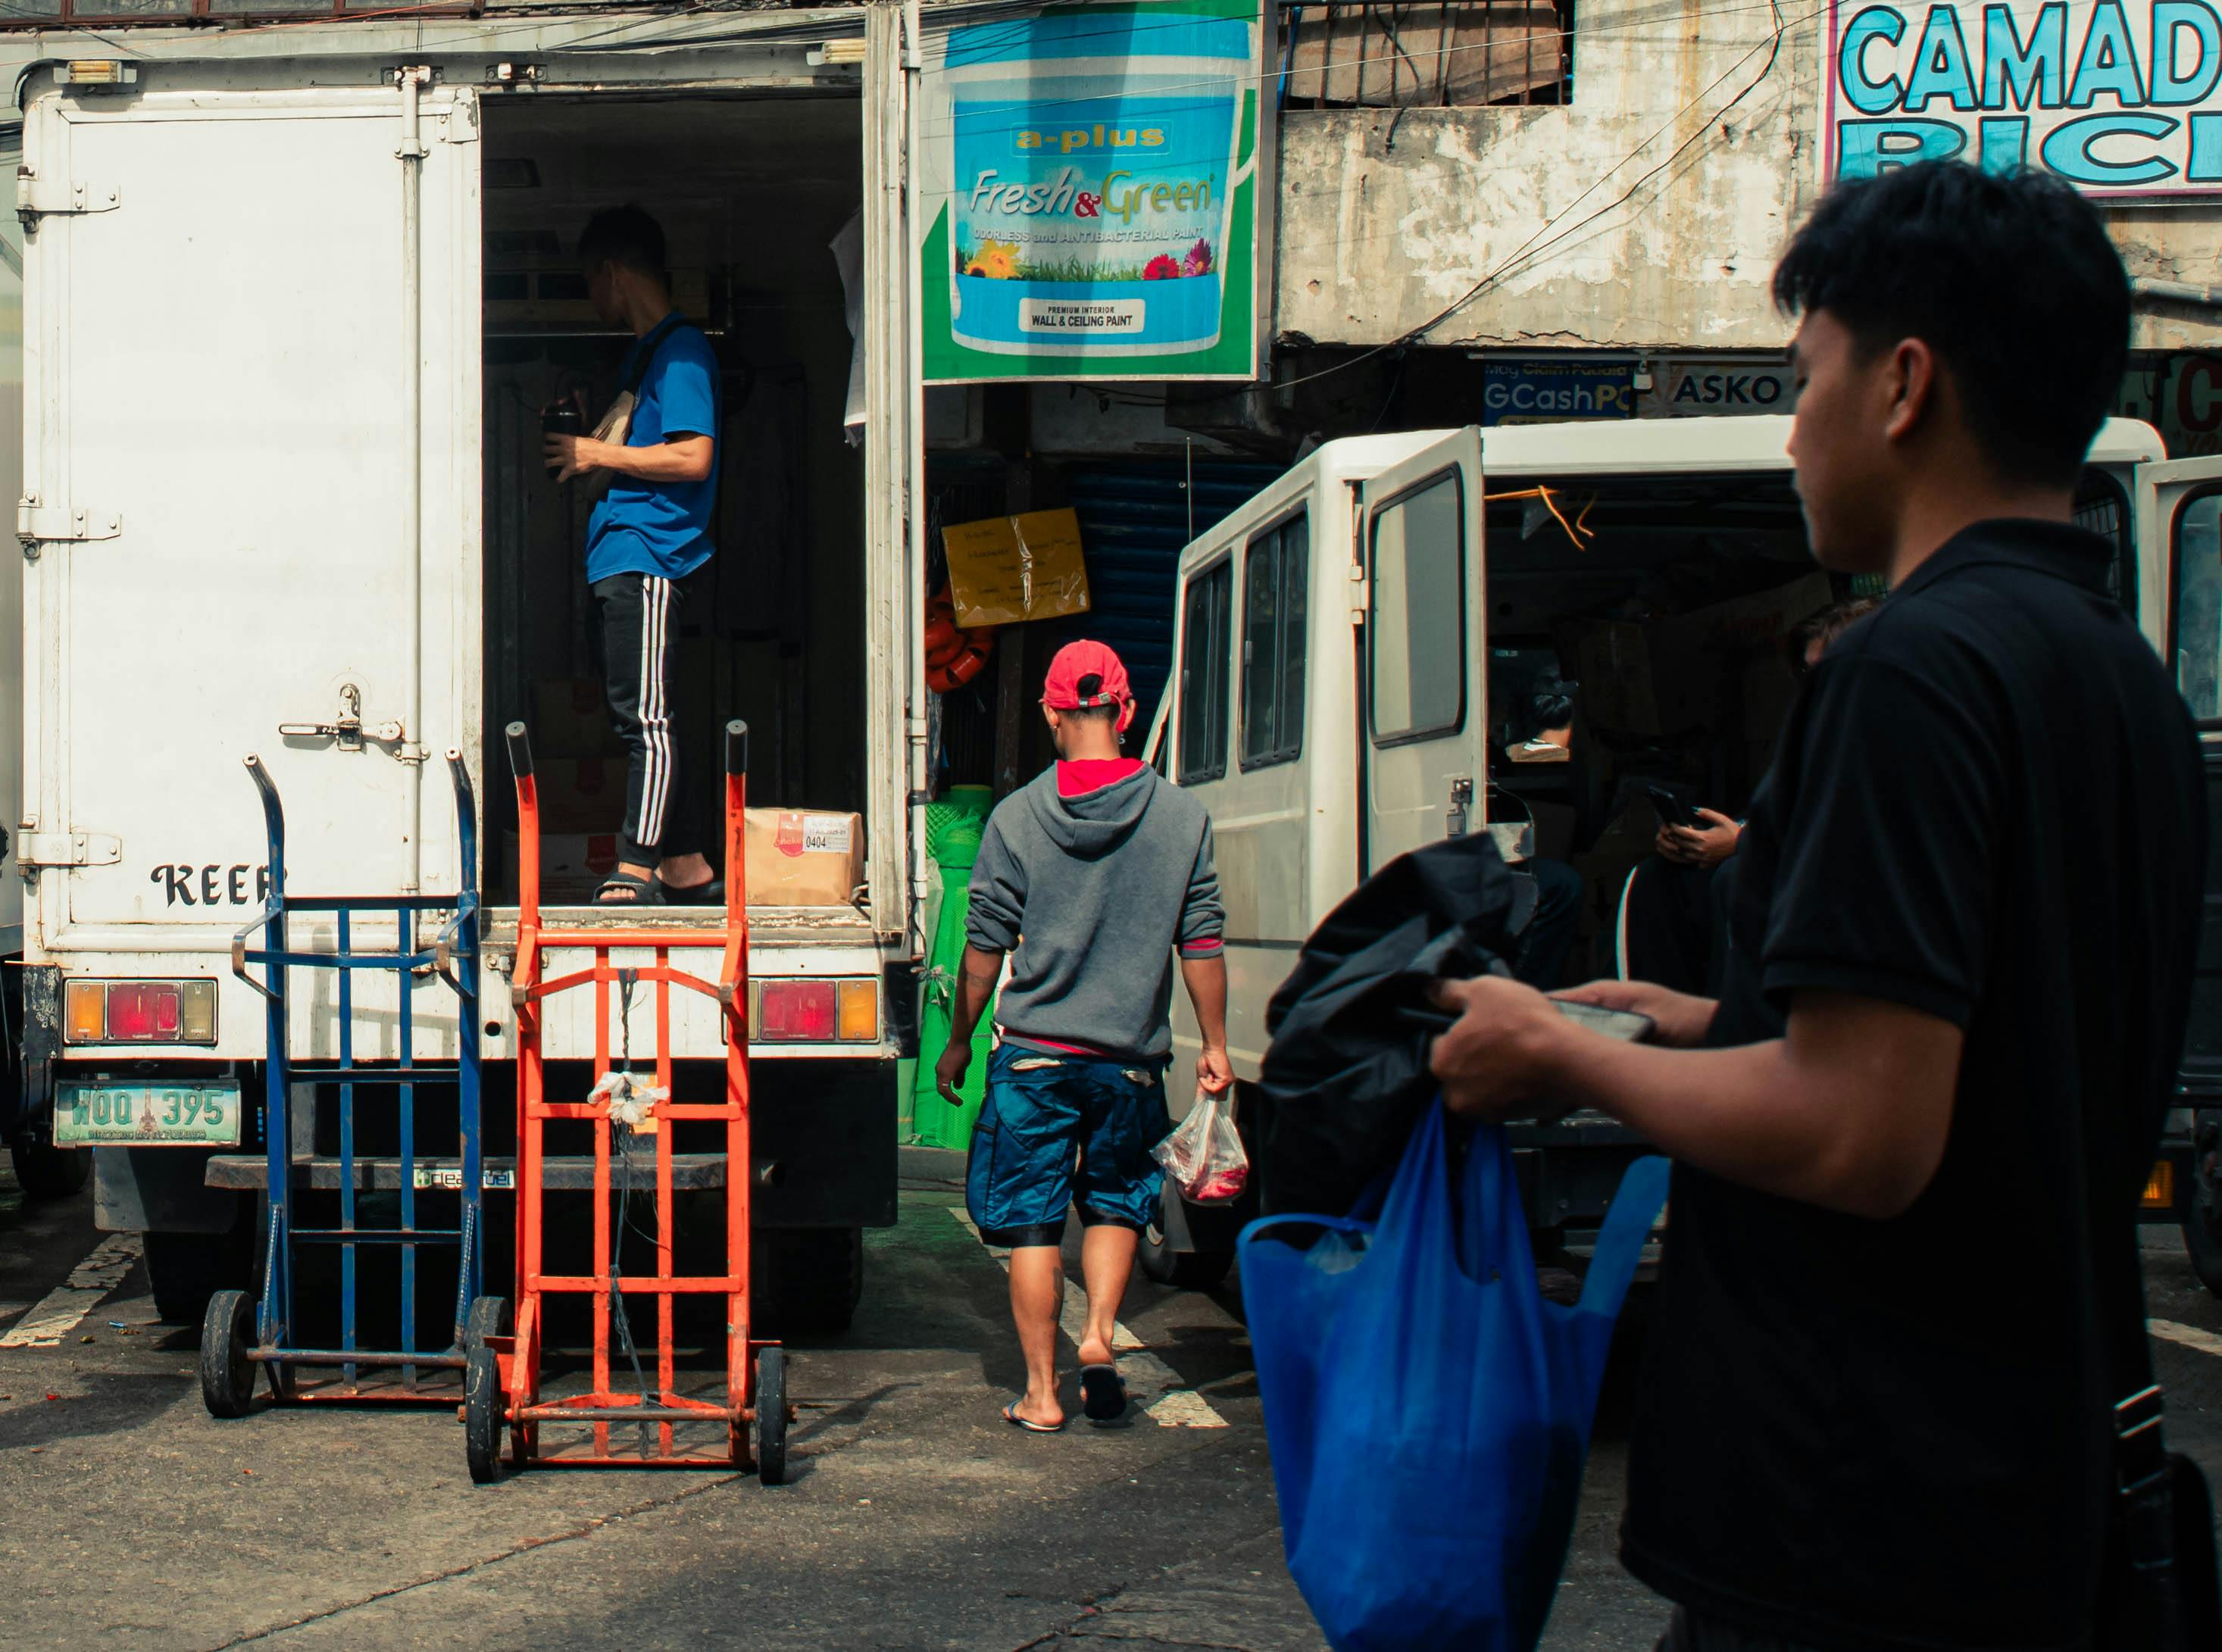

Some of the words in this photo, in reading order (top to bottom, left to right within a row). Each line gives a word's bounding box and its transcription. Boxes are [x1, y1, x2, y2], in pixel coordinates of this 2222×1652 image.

[1838, 0, 2222, 116] CAMAD
[1016, 124, 1165, 154] a-plus
[969, 167, 1074, 215] Fresh
[1102, 170, 1211, 225] Green
[974, 230, 1030, 242] ODORLESS
[1033, 230, 1058, 243] and
[1060, 229, 1169, 243] ANTIBACTERIAL
[1172, 227, 1204, 240] PAINT
[1032, 315, 1057, 326] WALL
[1058, 315, 1066, 326] &
[1067, 315, 1104, 327] CEILING
[1106, 315, 1133, 326] PAINT
[1048, 306, 1080, 314] PREMIUM
[1082, 306, 1114, 314] INTERIOR
[1674, 374, 1781, 405] ASKO
[806, 835, 826, 848] 0404
[161, 1089, 224, 1126] 395
